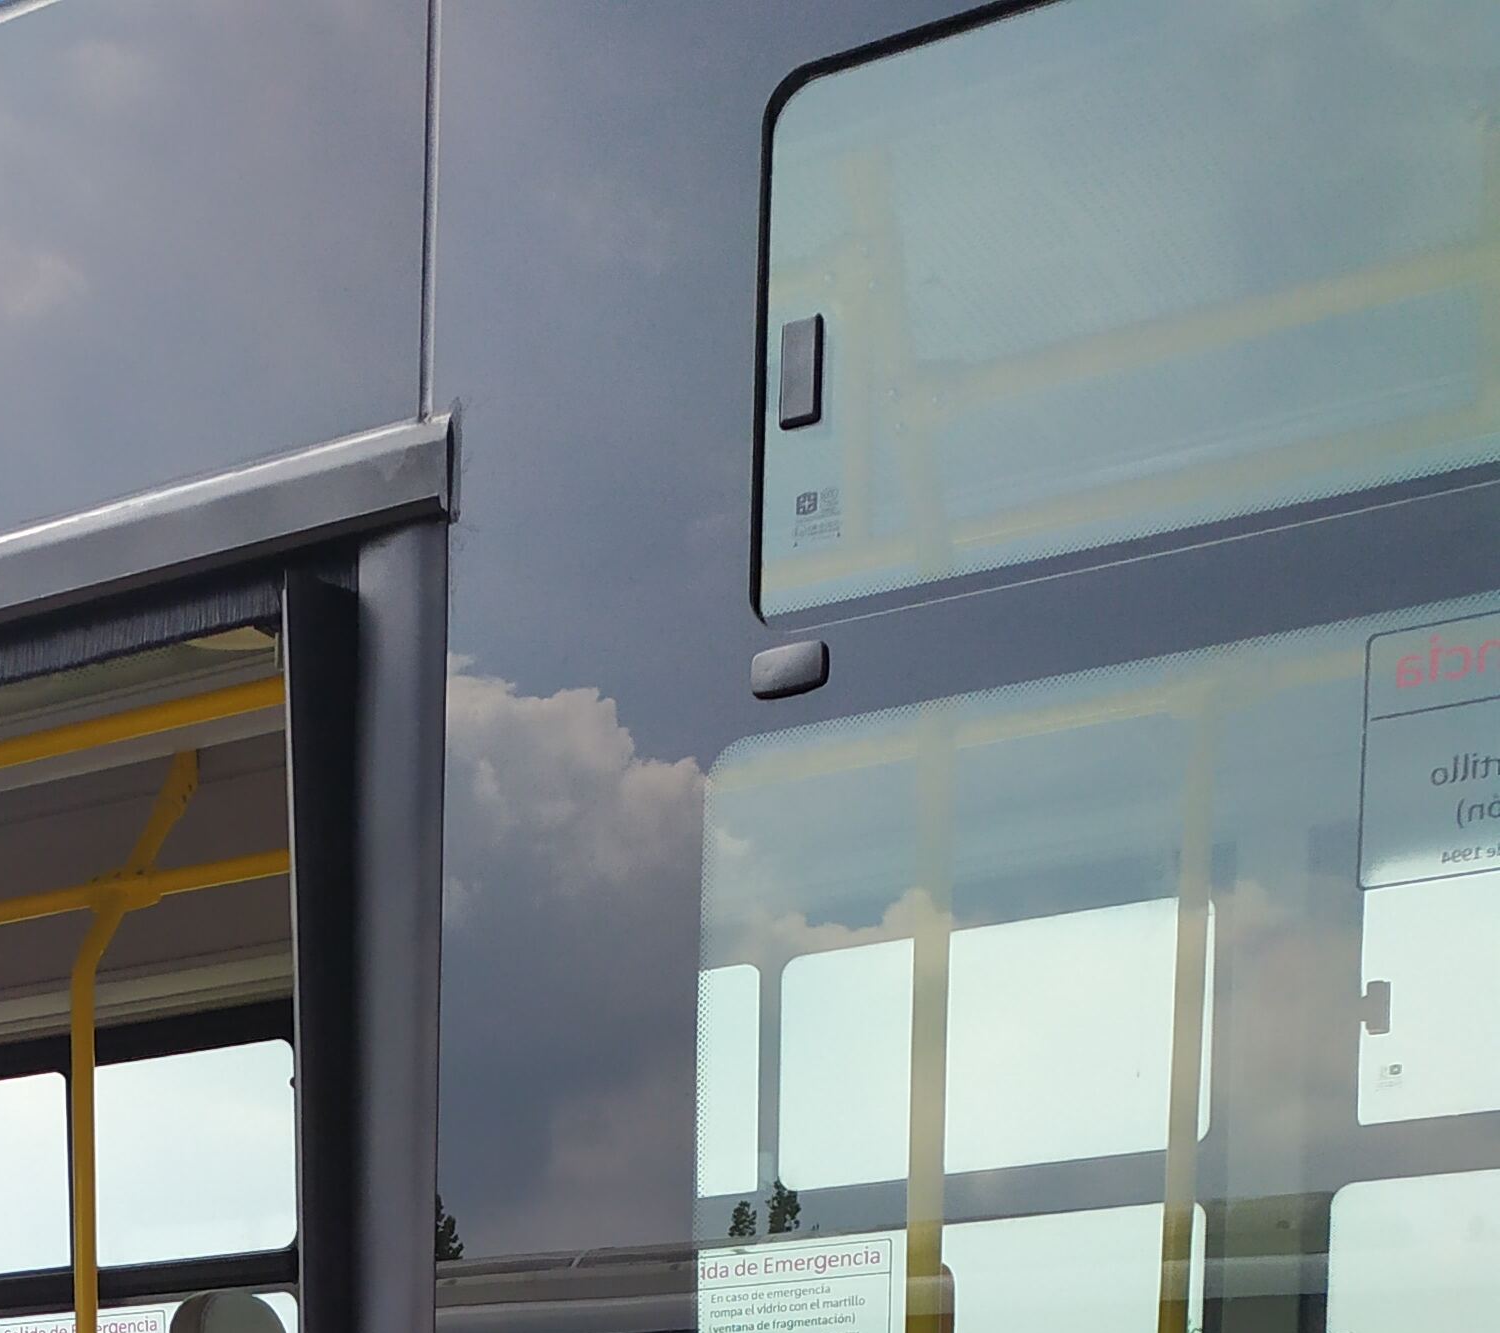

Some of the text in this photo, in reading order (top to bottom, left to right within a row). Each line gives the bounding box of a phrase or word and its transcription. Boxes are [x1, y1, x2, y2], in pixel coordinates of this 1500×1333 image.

[734, 1258, 758, 1276] de
[763, 1246, 881, 1274] Emergencia
[710, 1283, 831, 1304] En caso de emergencia
[709, 1295, 866, 1319] rompa el vidrio con el martillo
[756, 1320, 770, 1330] de
[772, 1312, 856, 1331] fragmentación)
